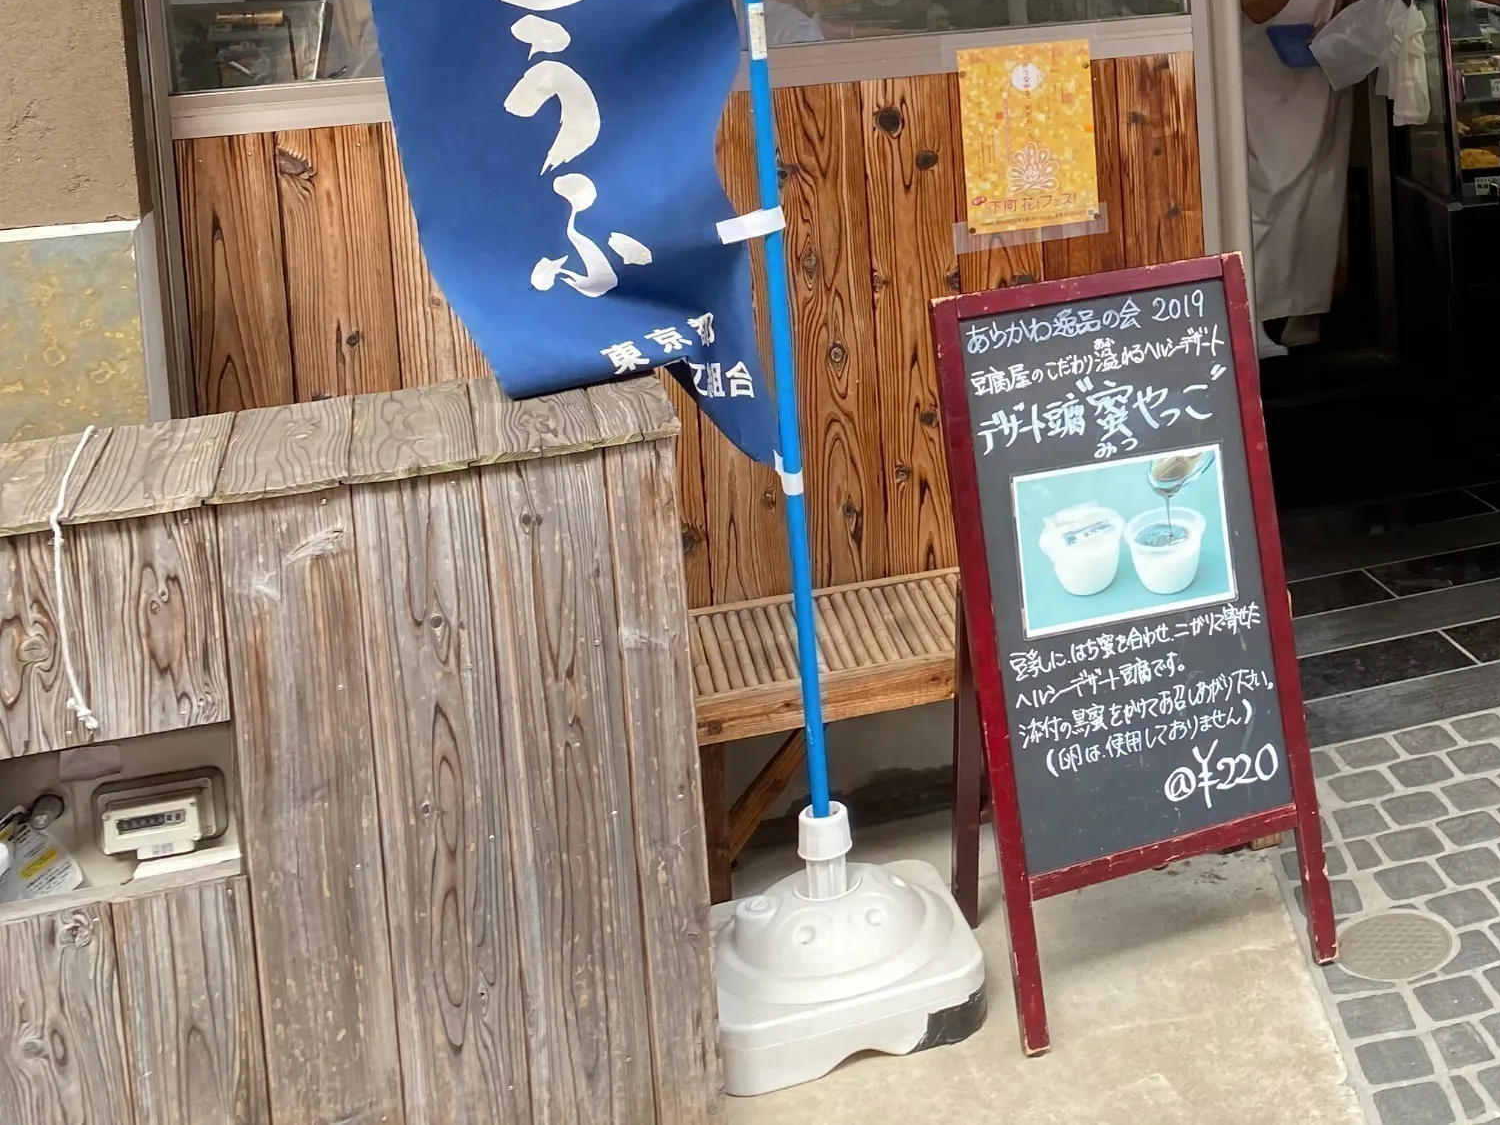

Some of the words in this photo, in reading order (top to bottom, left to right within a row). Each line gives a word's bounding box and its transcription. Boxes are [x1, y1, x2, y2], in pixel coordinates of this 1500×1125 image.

[966, 296, 1142, 354] あらかわ逸品の会
[1152, 289, 1205, 322] 2019
[1093, 437, 1139, 459] みつ
